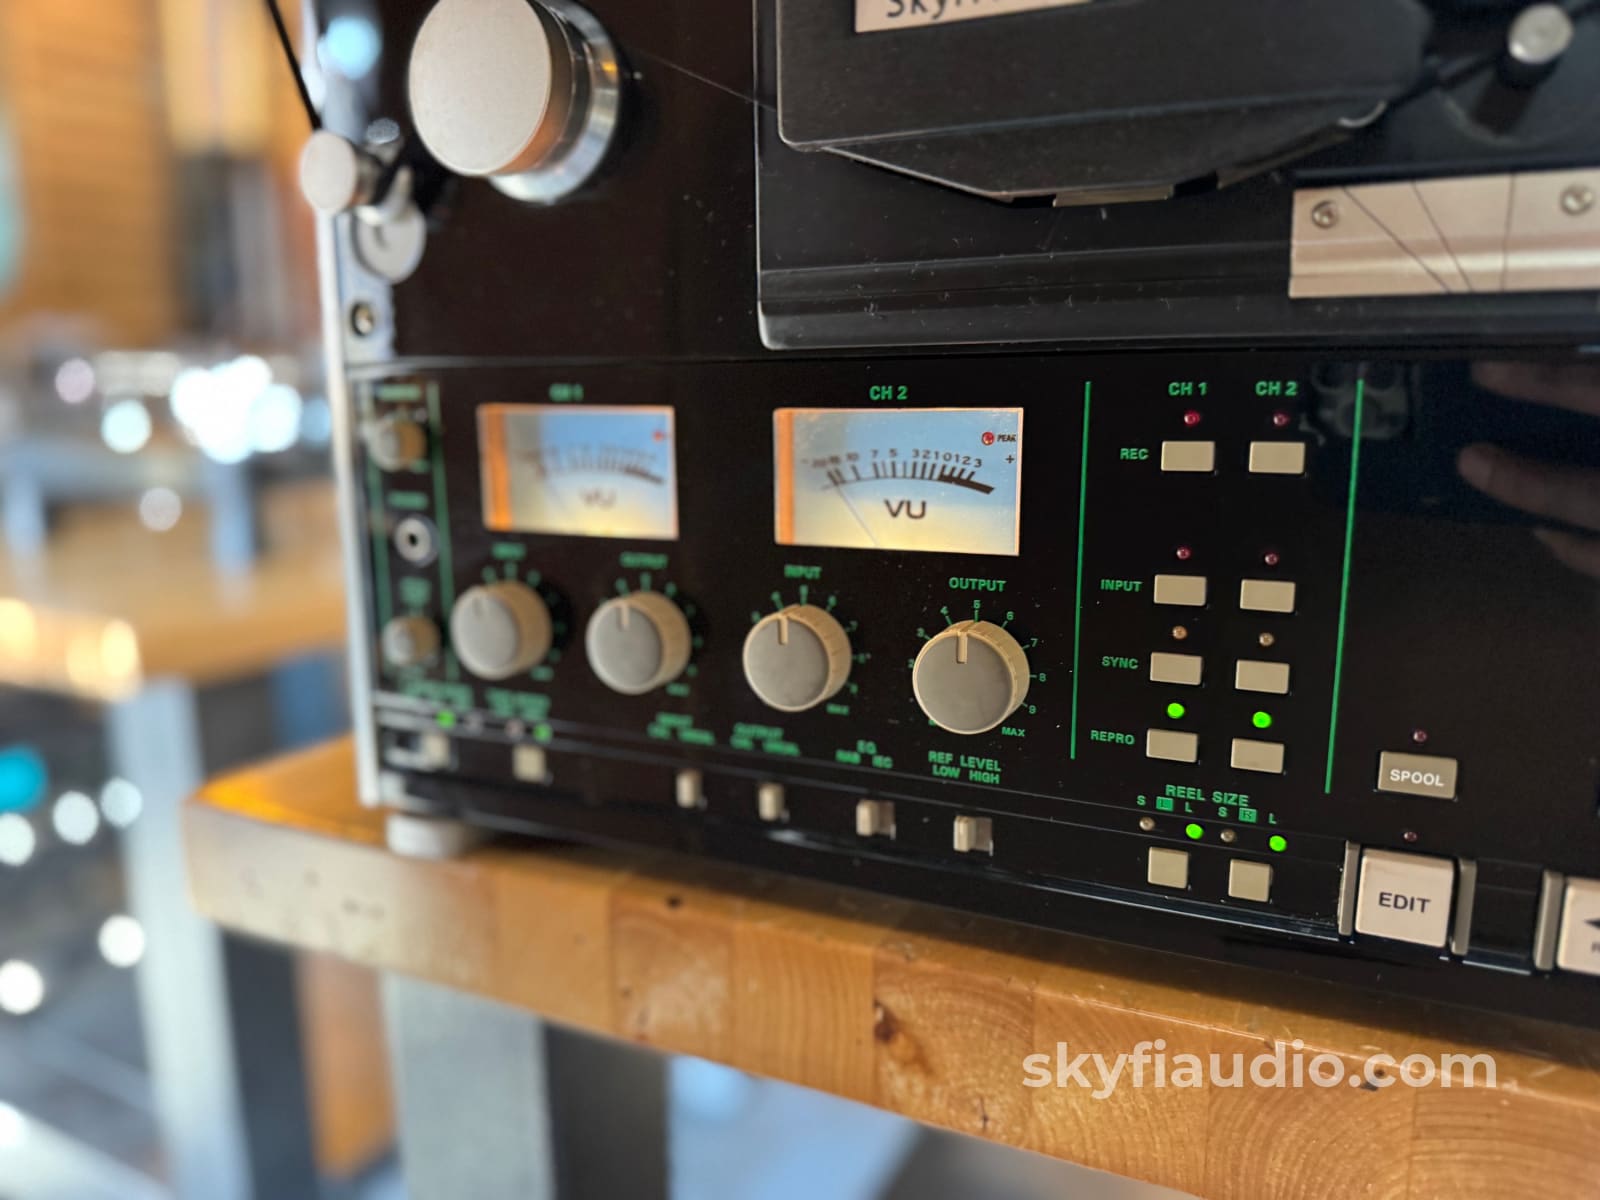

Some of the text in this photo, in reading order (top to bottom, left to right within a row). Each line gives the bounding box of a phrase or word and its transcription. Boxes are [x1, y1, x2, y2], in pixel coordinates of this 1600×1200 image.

[869, 386, 907, 400] CH 2
[1168, 382, 1208, 396] CH 1
[1256, 381, 1297, 396] CH 2
[1120, 448, 1149, 461] REC
[884, 500, 926, 519] VU
[949, 577, 1007, 592] OUTPUT
[1101, 579, 1143, 592] INPUT
[940, 606, 948, 615] 4
[973, 600, 981, 609] 5
[1006, 611, 1014, 620] 6
[1030, 638, 1038, 647] 7
[1102, 656, 1139, 670] SYNC
[1039, 673, 1047, 682] 8
[1028, 705, 1036, 714] 9
[1001, 727, 1025, 737] MAX
[1091, 730, 1135, 745] REPRO
[928, 751, 1001, 772] REF LEVEL
[932, 765, 1000, 784] LOW HIGH
[1390, 769, 1444, 787] SPOOL
[1165, 784, 1249, 807] REEL SIZE
[1137, 795, 1146, 805] S
[1185, 802, 1193, 813] L
[1218, 806, 1228, 817] S
[1269, 813, 1277, 824] L
[1379, 891, 1430, 914] EDIT
